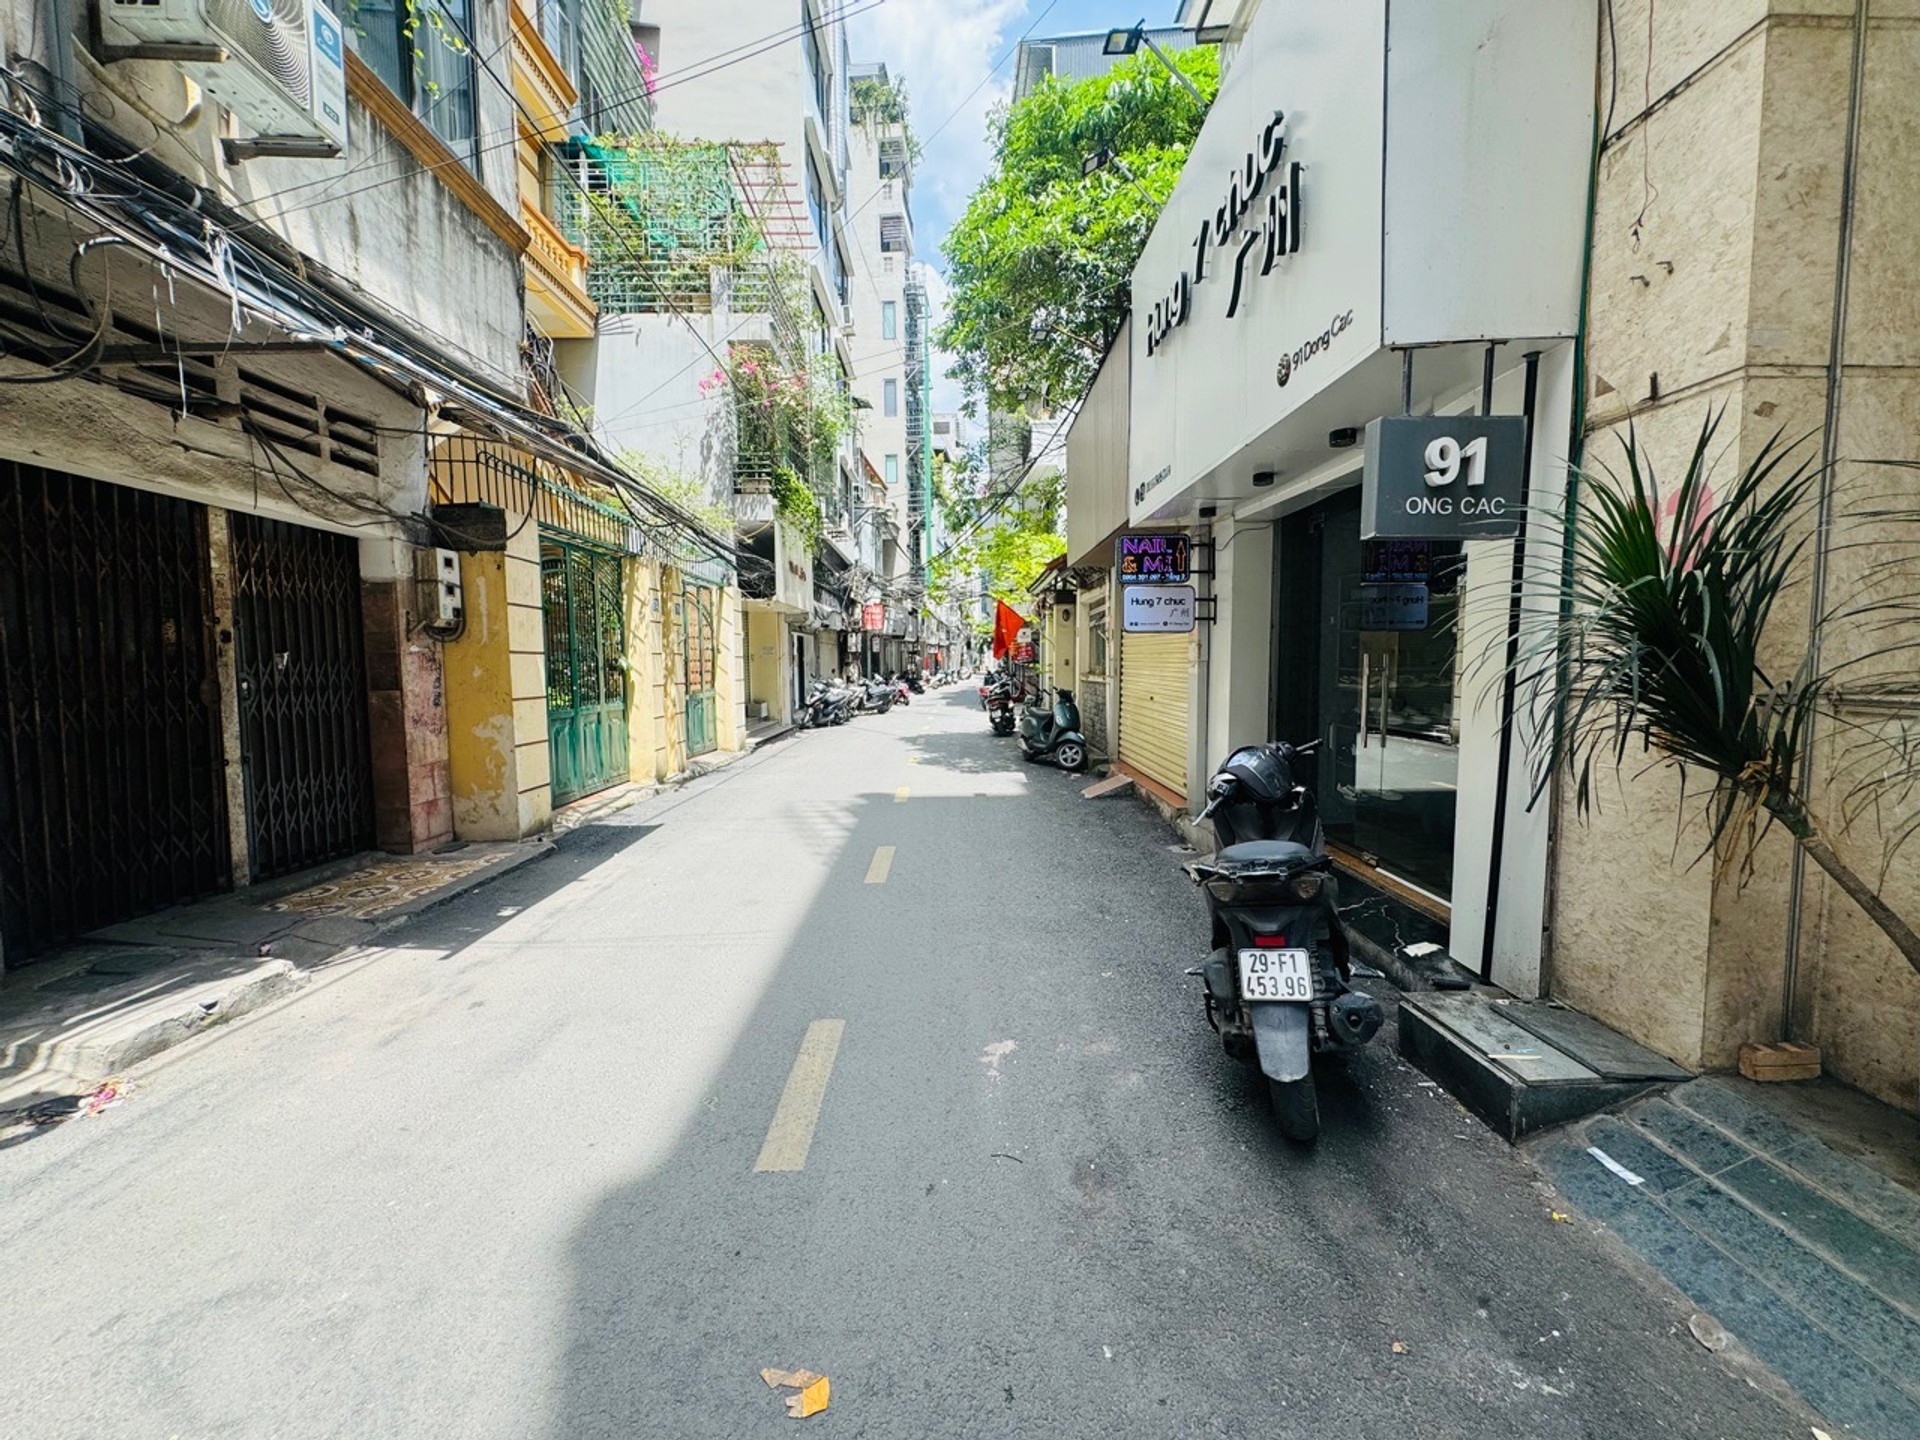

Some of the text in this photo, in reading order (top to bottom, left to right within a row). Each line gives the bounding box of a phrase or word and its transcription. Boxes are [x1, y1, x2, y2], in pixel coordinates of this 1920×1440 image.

[1292, 308, 1354, 372] 91 Dong Cac
[1423, 436, 1488, 488] 91
[1405, 496, 1506, 515] ONG CAC
[1123, 538, 1173, 554] NAIL
[1121, 555, 1138, 573] &
[1131, 597, 1186, 608] Hung 7 chuc
[1248, 953, 1298, 974] 29-F1
[1246, 976, 1308, 997] 453.96
